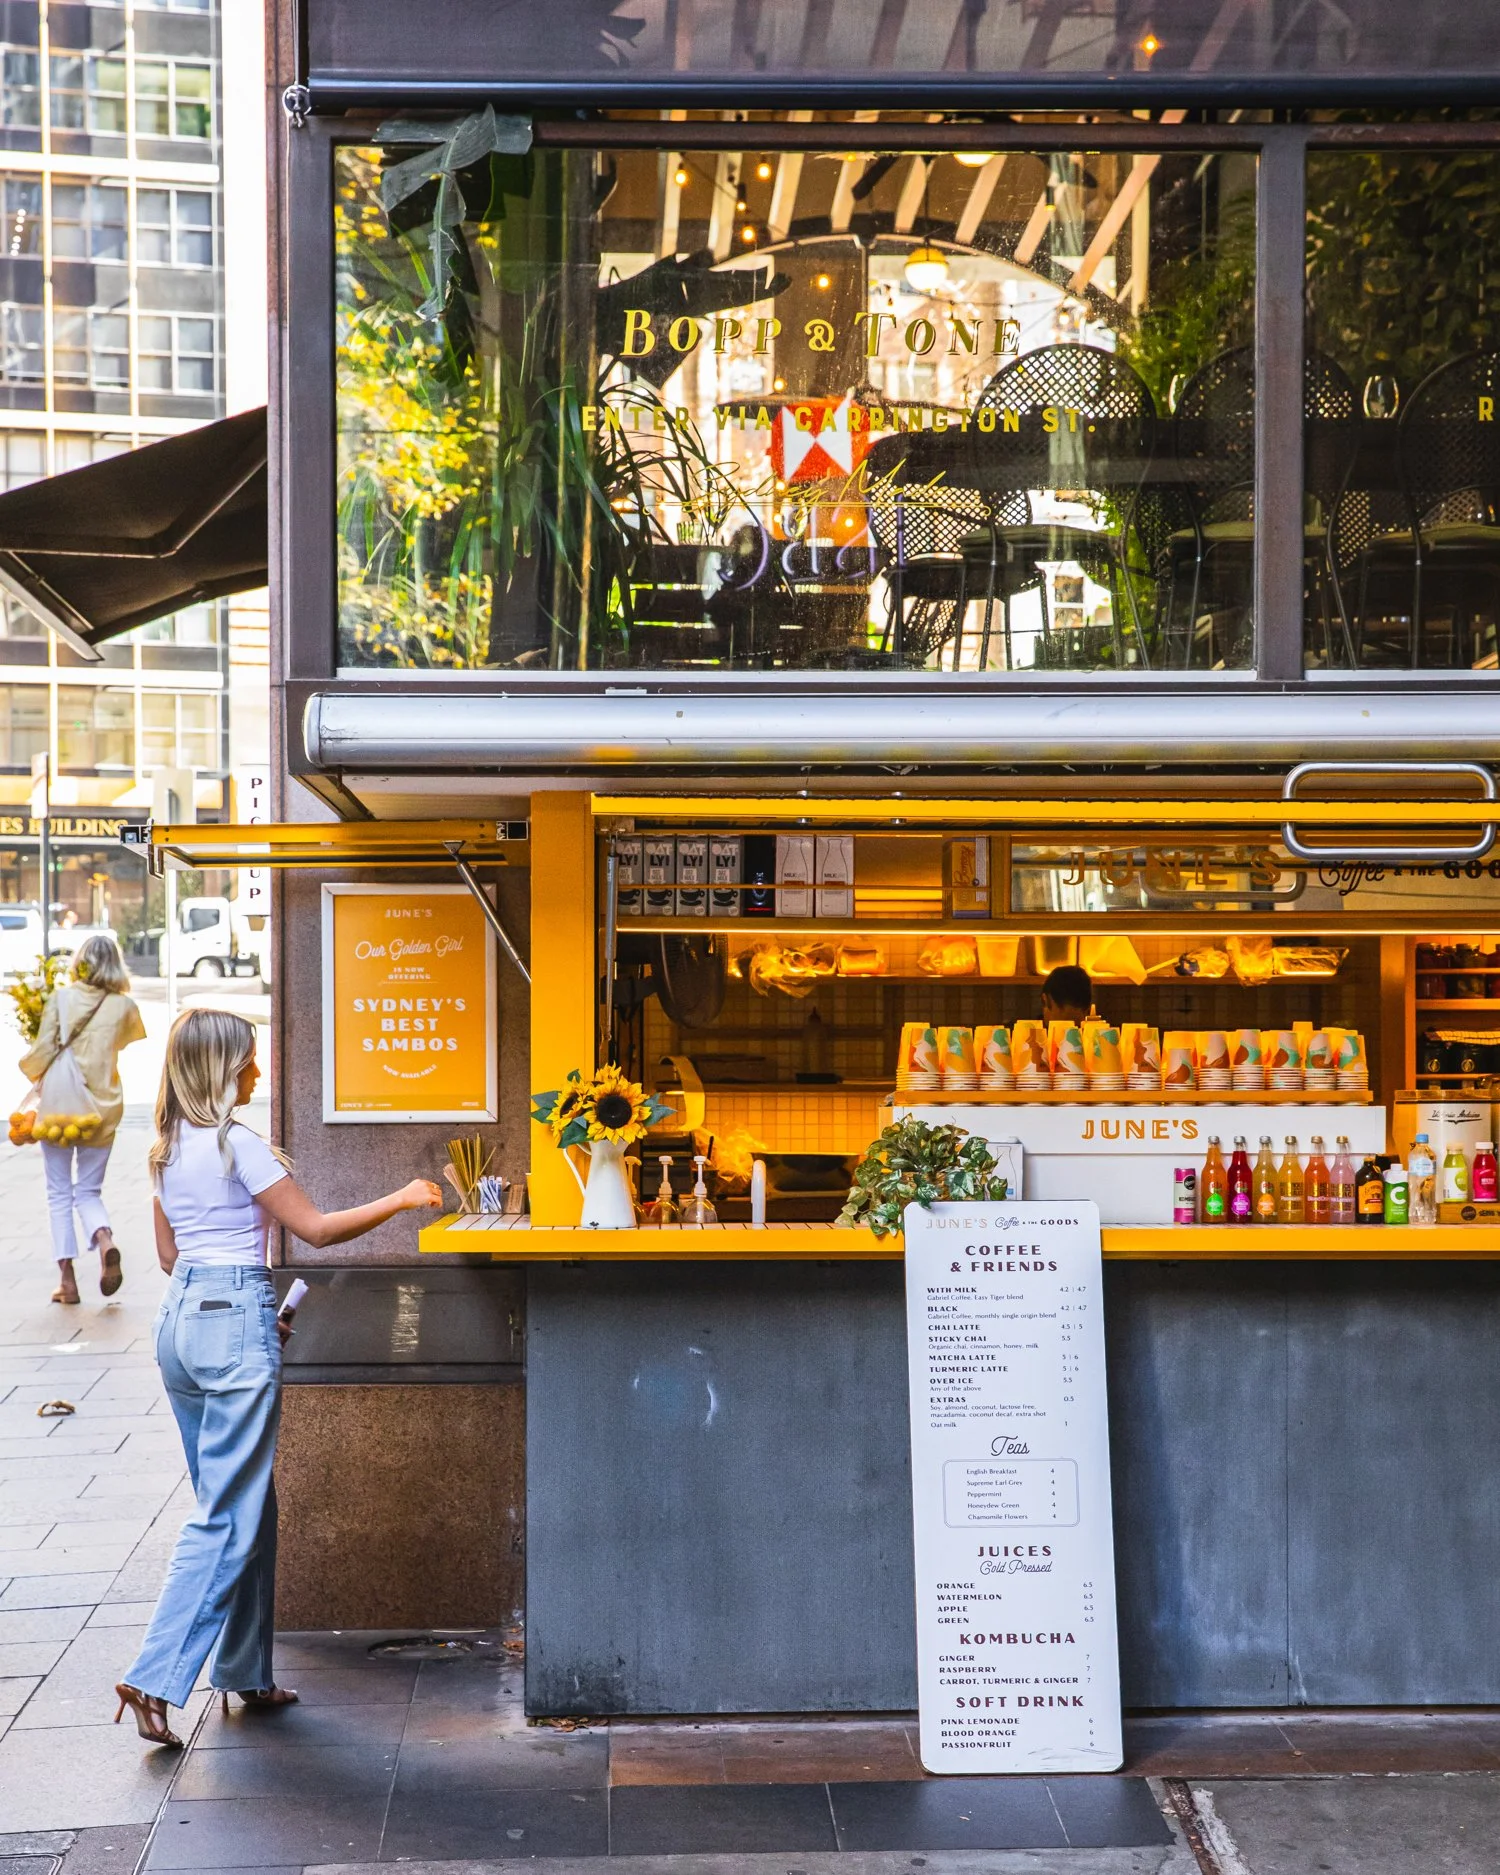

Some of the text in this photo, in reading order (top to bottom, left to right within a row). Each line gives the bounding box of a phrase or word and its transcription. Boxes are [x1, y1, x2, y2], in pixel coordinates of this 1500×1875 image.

[619, 309, 1022, 358] BOPP & TONE
[582, 406, 1096, 433] ENTER VIA CARRINGTON ST.
[1063, 850, 1282, 886] JUNE'S
[1319, 860, 1385, 896] Coffee
[385, 908, 433, 919] JUNE'S
[355, 935, 464, 961] Our Golden Girl
[353, 998, 466, 1012] SYDNEY'S
[381, 1018, 438, 1032] BEST
[362, 1038, 458, 1052] SAMBOS
[1082, 1119, 1199, 1140] JUNE'S
[1390, 1186, 1406, 1205] C
[926, 1218, 988, 1229] JUNE'S
[995, 1216, 1020, 1230] Coffee
[965, 1245, 1042, 1256] COFFEE
[950, 1261, 1058, 1272] & FRIENDS
[991, 1436, 1030, 1456] Teas
[978, 1546, 1052, 1557] JUICES
[980, 1559, 1053, 1575] Cold Pressed
[960, 1633, 1076, 1644] KOMBUCHA
[956, 1696, 1084, 1708] SOFT DRINK
